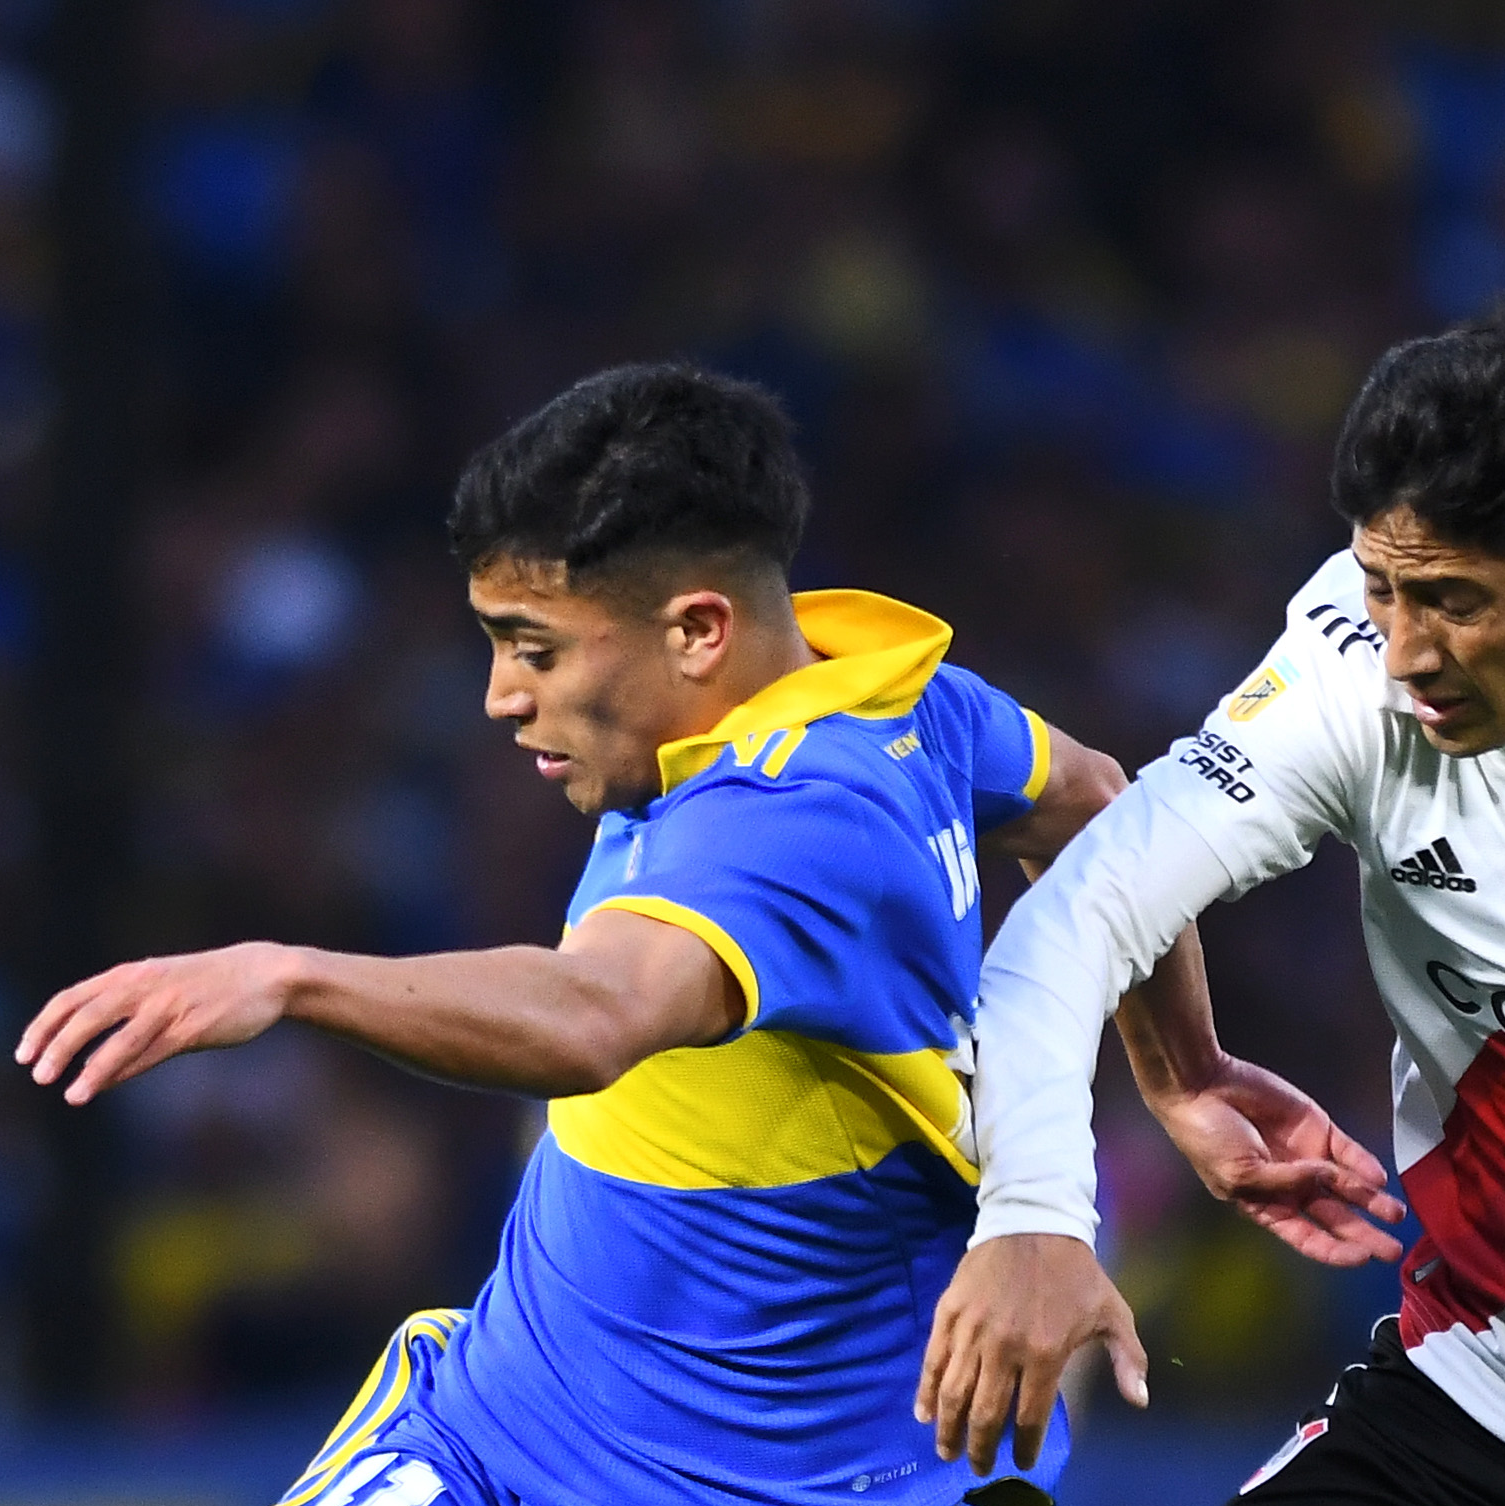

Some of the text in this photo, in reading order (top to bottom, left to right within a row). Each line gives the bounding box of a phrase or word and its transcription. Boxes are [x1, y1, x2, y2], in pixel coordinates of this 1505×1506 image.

[1193, 730, 1255, 773] SIST
[1178, 748, 1256, 804] CARD
[1390, 866, 1477, 893] adidas
